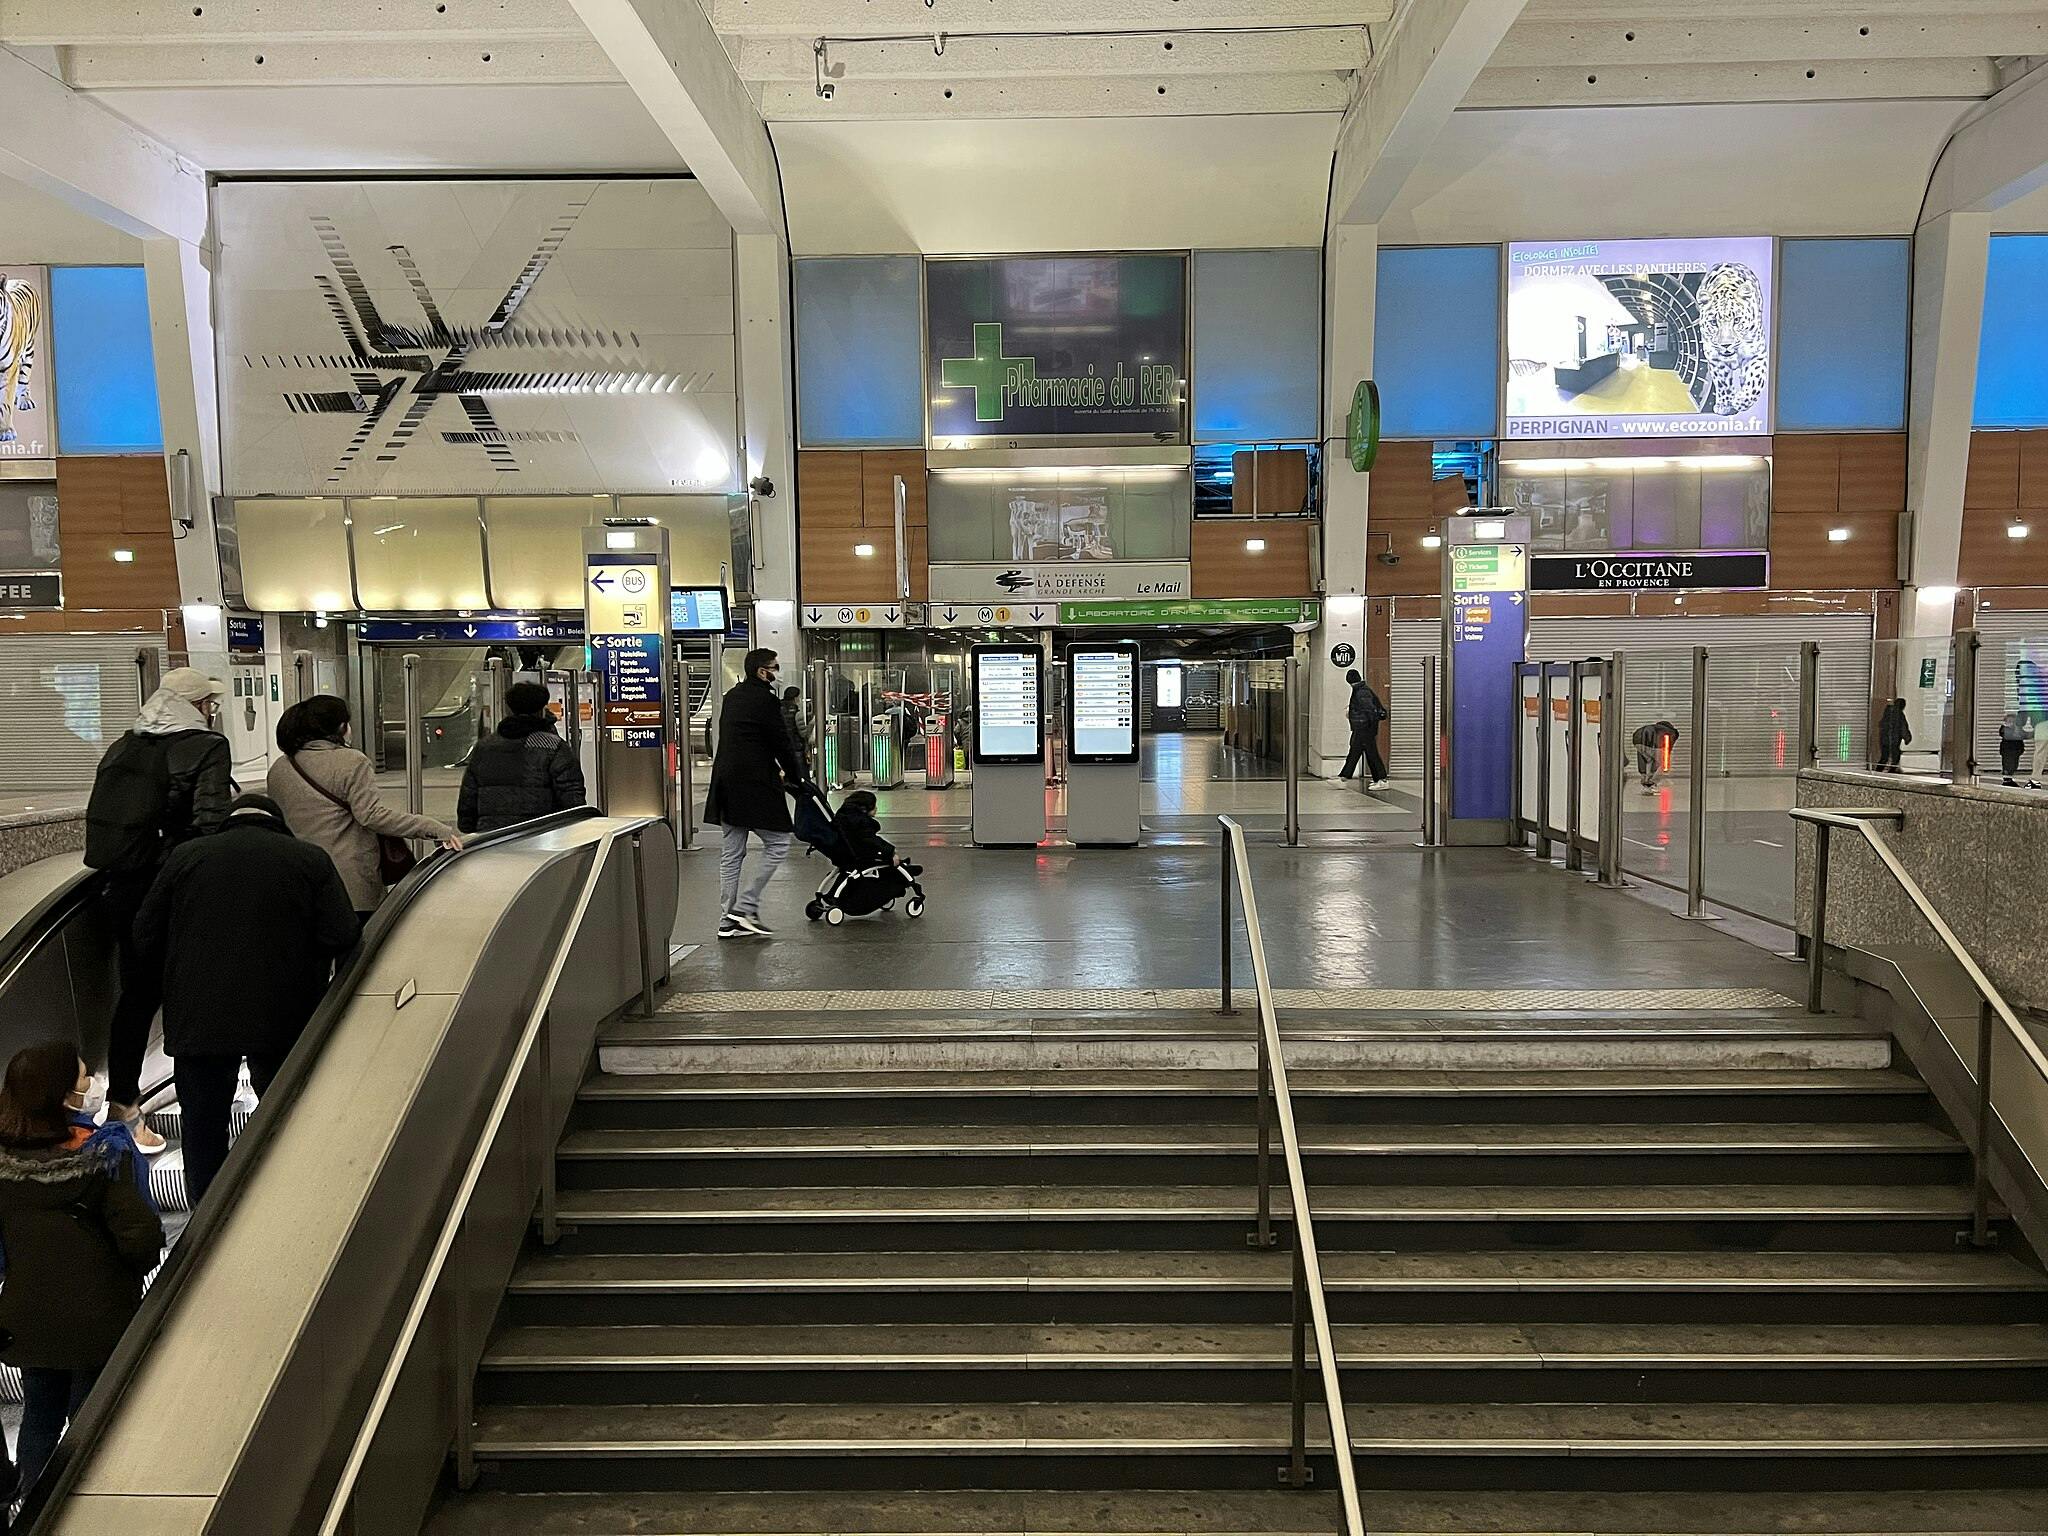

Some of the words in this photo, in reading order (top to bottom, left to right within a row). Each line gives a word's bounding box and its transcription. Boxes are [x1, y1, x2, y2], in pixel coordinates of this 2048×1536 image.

[1561, 244, 1599, 257] INSOLITES
[1524, 265, 1574, 276] DORMEZ
[1578, 264, 1608, 275] AVEC
[1611, 264, 1633, 274] LES
[1635, 262, 1707, 274] PANTHERES
[1006, 363, 1105, 407] Pharmacie
[1110, 362, 1135, 406] du
[1140, 364, 1174, 405] RER
[1509, 420, 1608, 434] PERPIGNAN
[1622, 416, 1763, 433] www.ecozonia.fr
[0, 440, 43, 455] nia.fr
[1575, 560, 1693, 578] L'OCCITANE
[625, 577, 643, 585] BUS
[1037, 579, 1050, 588] LA
[1056, 579, 1105, 587] DEFENSE
[1599, 579, 1611, 587] EN
[1616, 579, 1670, 587] PROVENCE
[0, 585, 31, 599] FEE
[1137, 583, 1151, 594] Le
[1154, 582, 1181, 593] Mail
[1453, 593, 1490, 606] Sortie
[1078, 610, 1155, 618] LABORATOIRE
[1161, 608, 1231, 616] D'ANALYSES
[1236, 607, 1300, 615] MEDICALES
[229, 620, 246, 630] Sortie
[517, 624, 554, 637] Sortie
[606, 636, 643, 648] Sortie
[627, 729, 656, 739] Sortie
